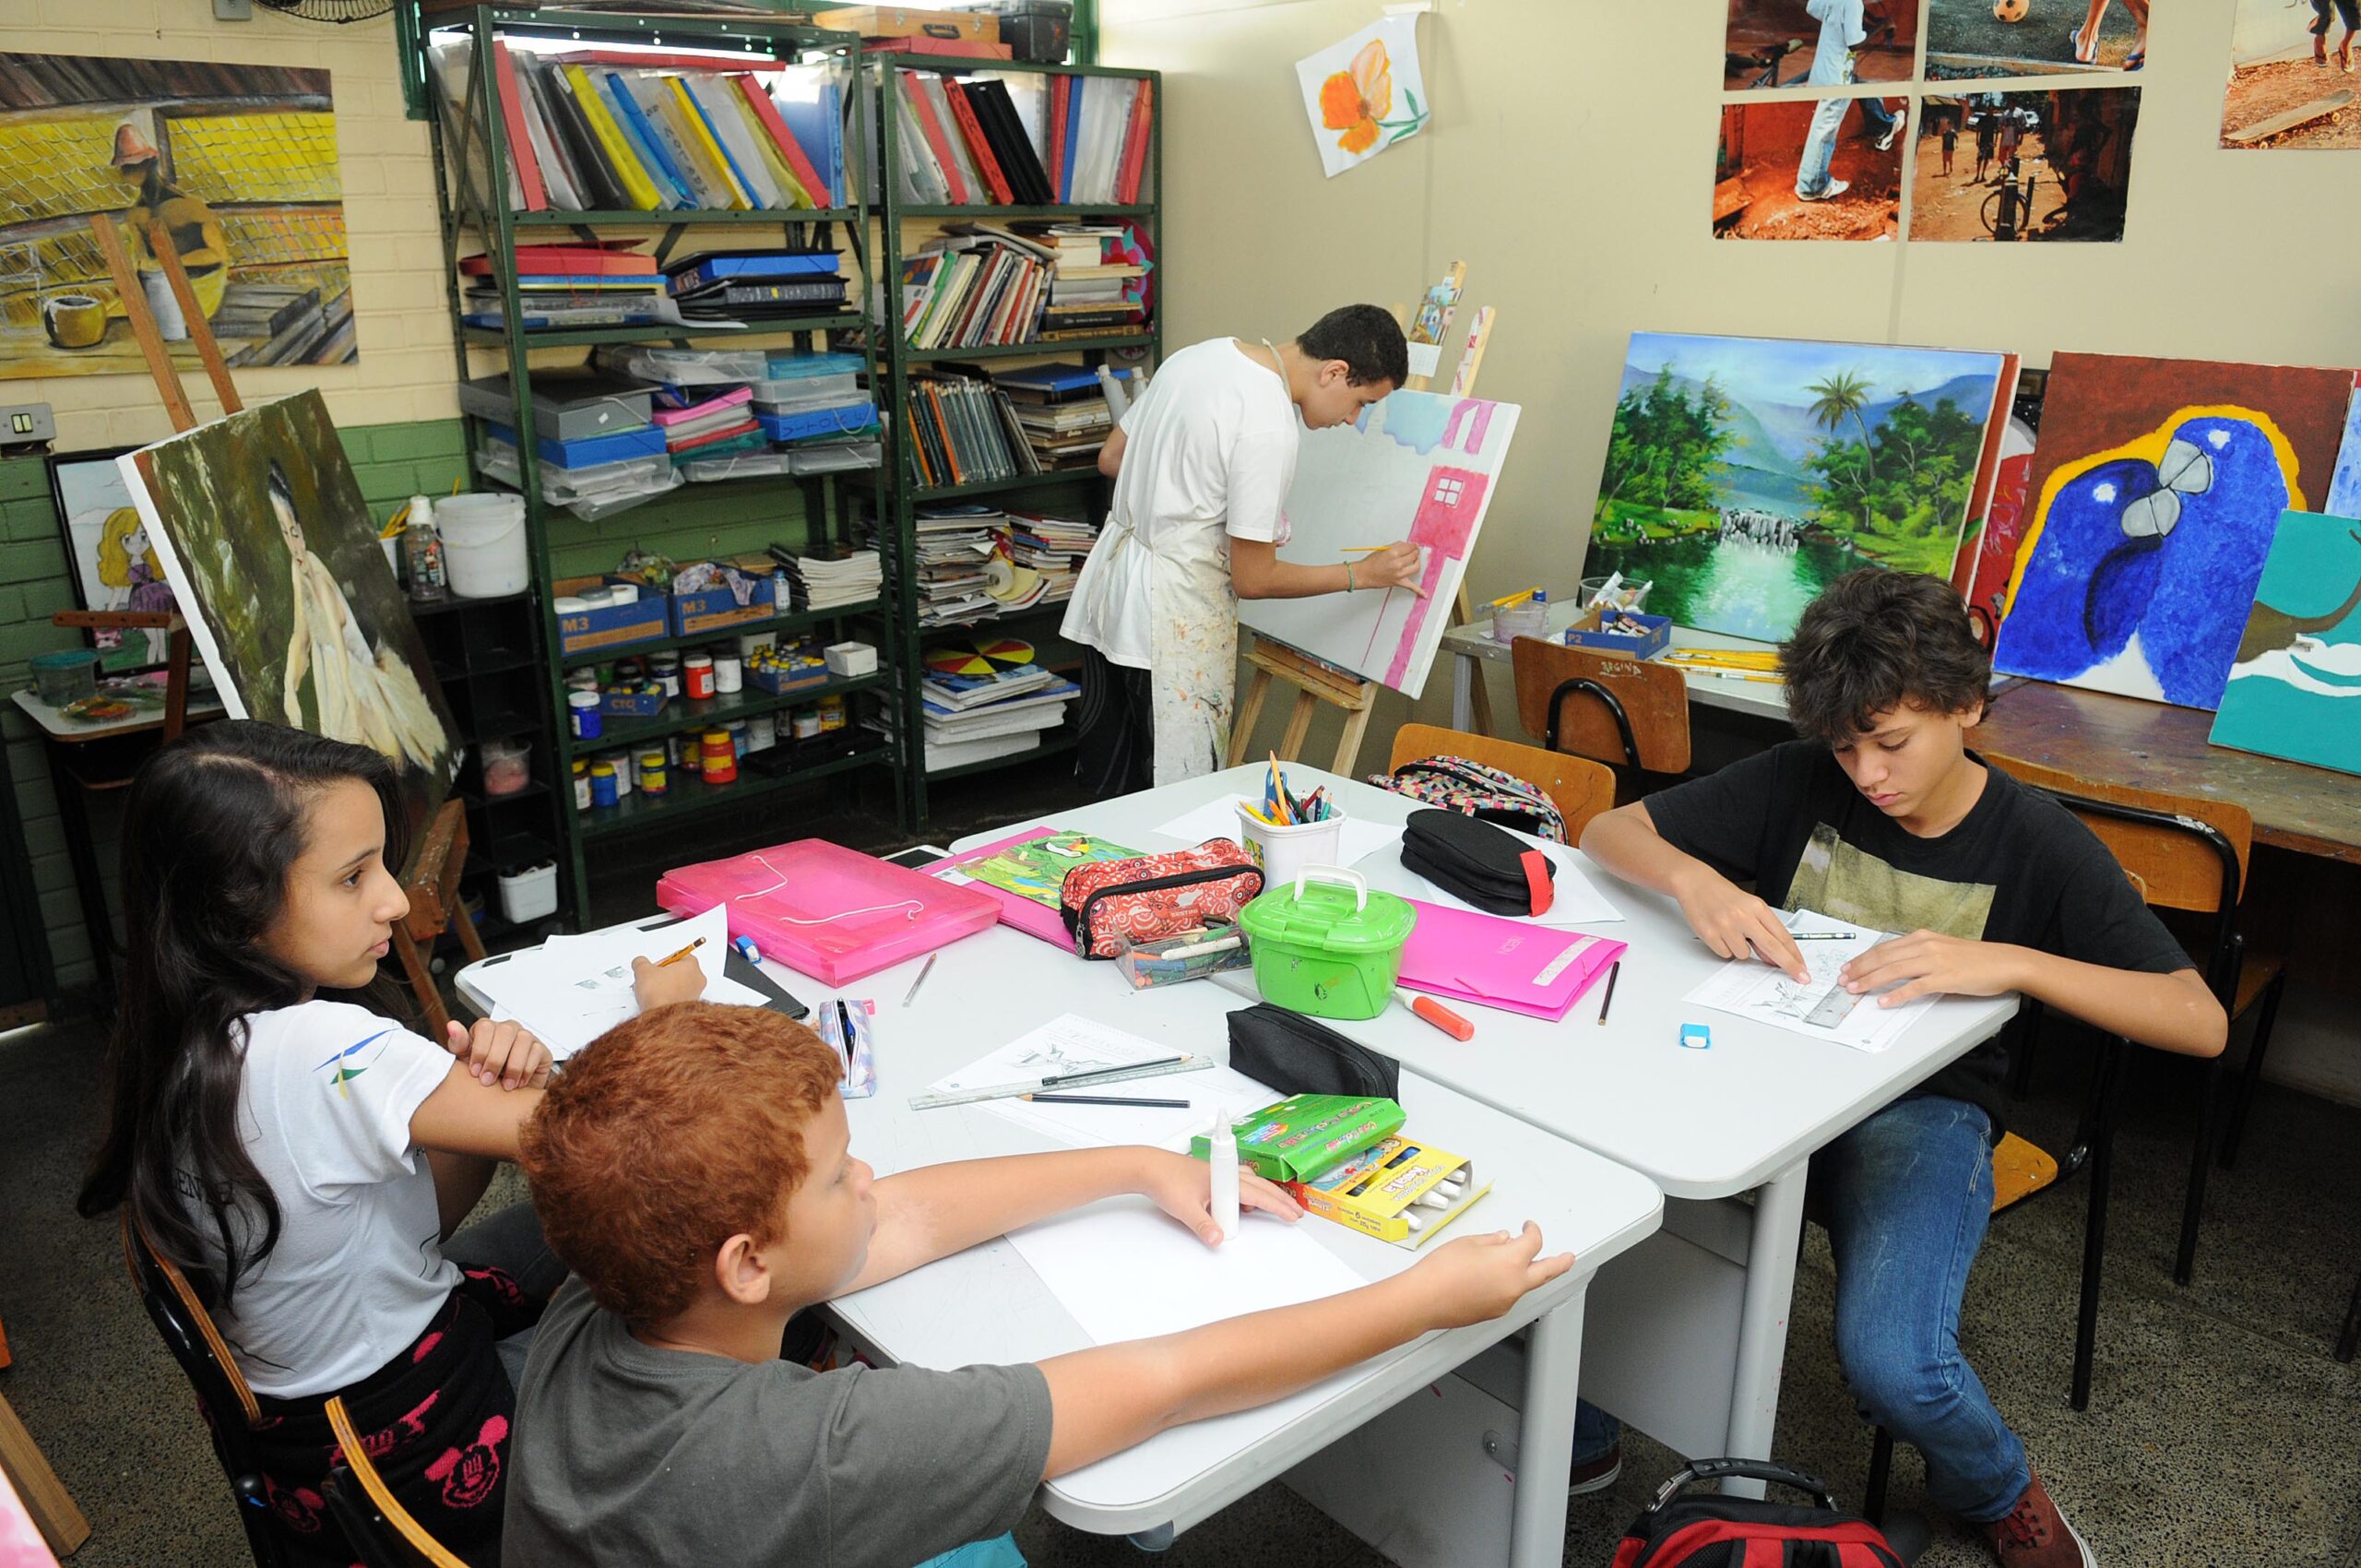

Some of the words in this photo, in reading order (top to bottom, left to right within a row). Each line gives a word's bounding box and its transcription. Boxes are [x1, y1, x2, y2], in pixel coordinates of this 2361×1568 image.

[682, 599, 707, 614] M3
[561, 616, 590, 633] M3
[1567, 633, 1583, 644] P2
[1355, 1211, 1361, 1219] 6
